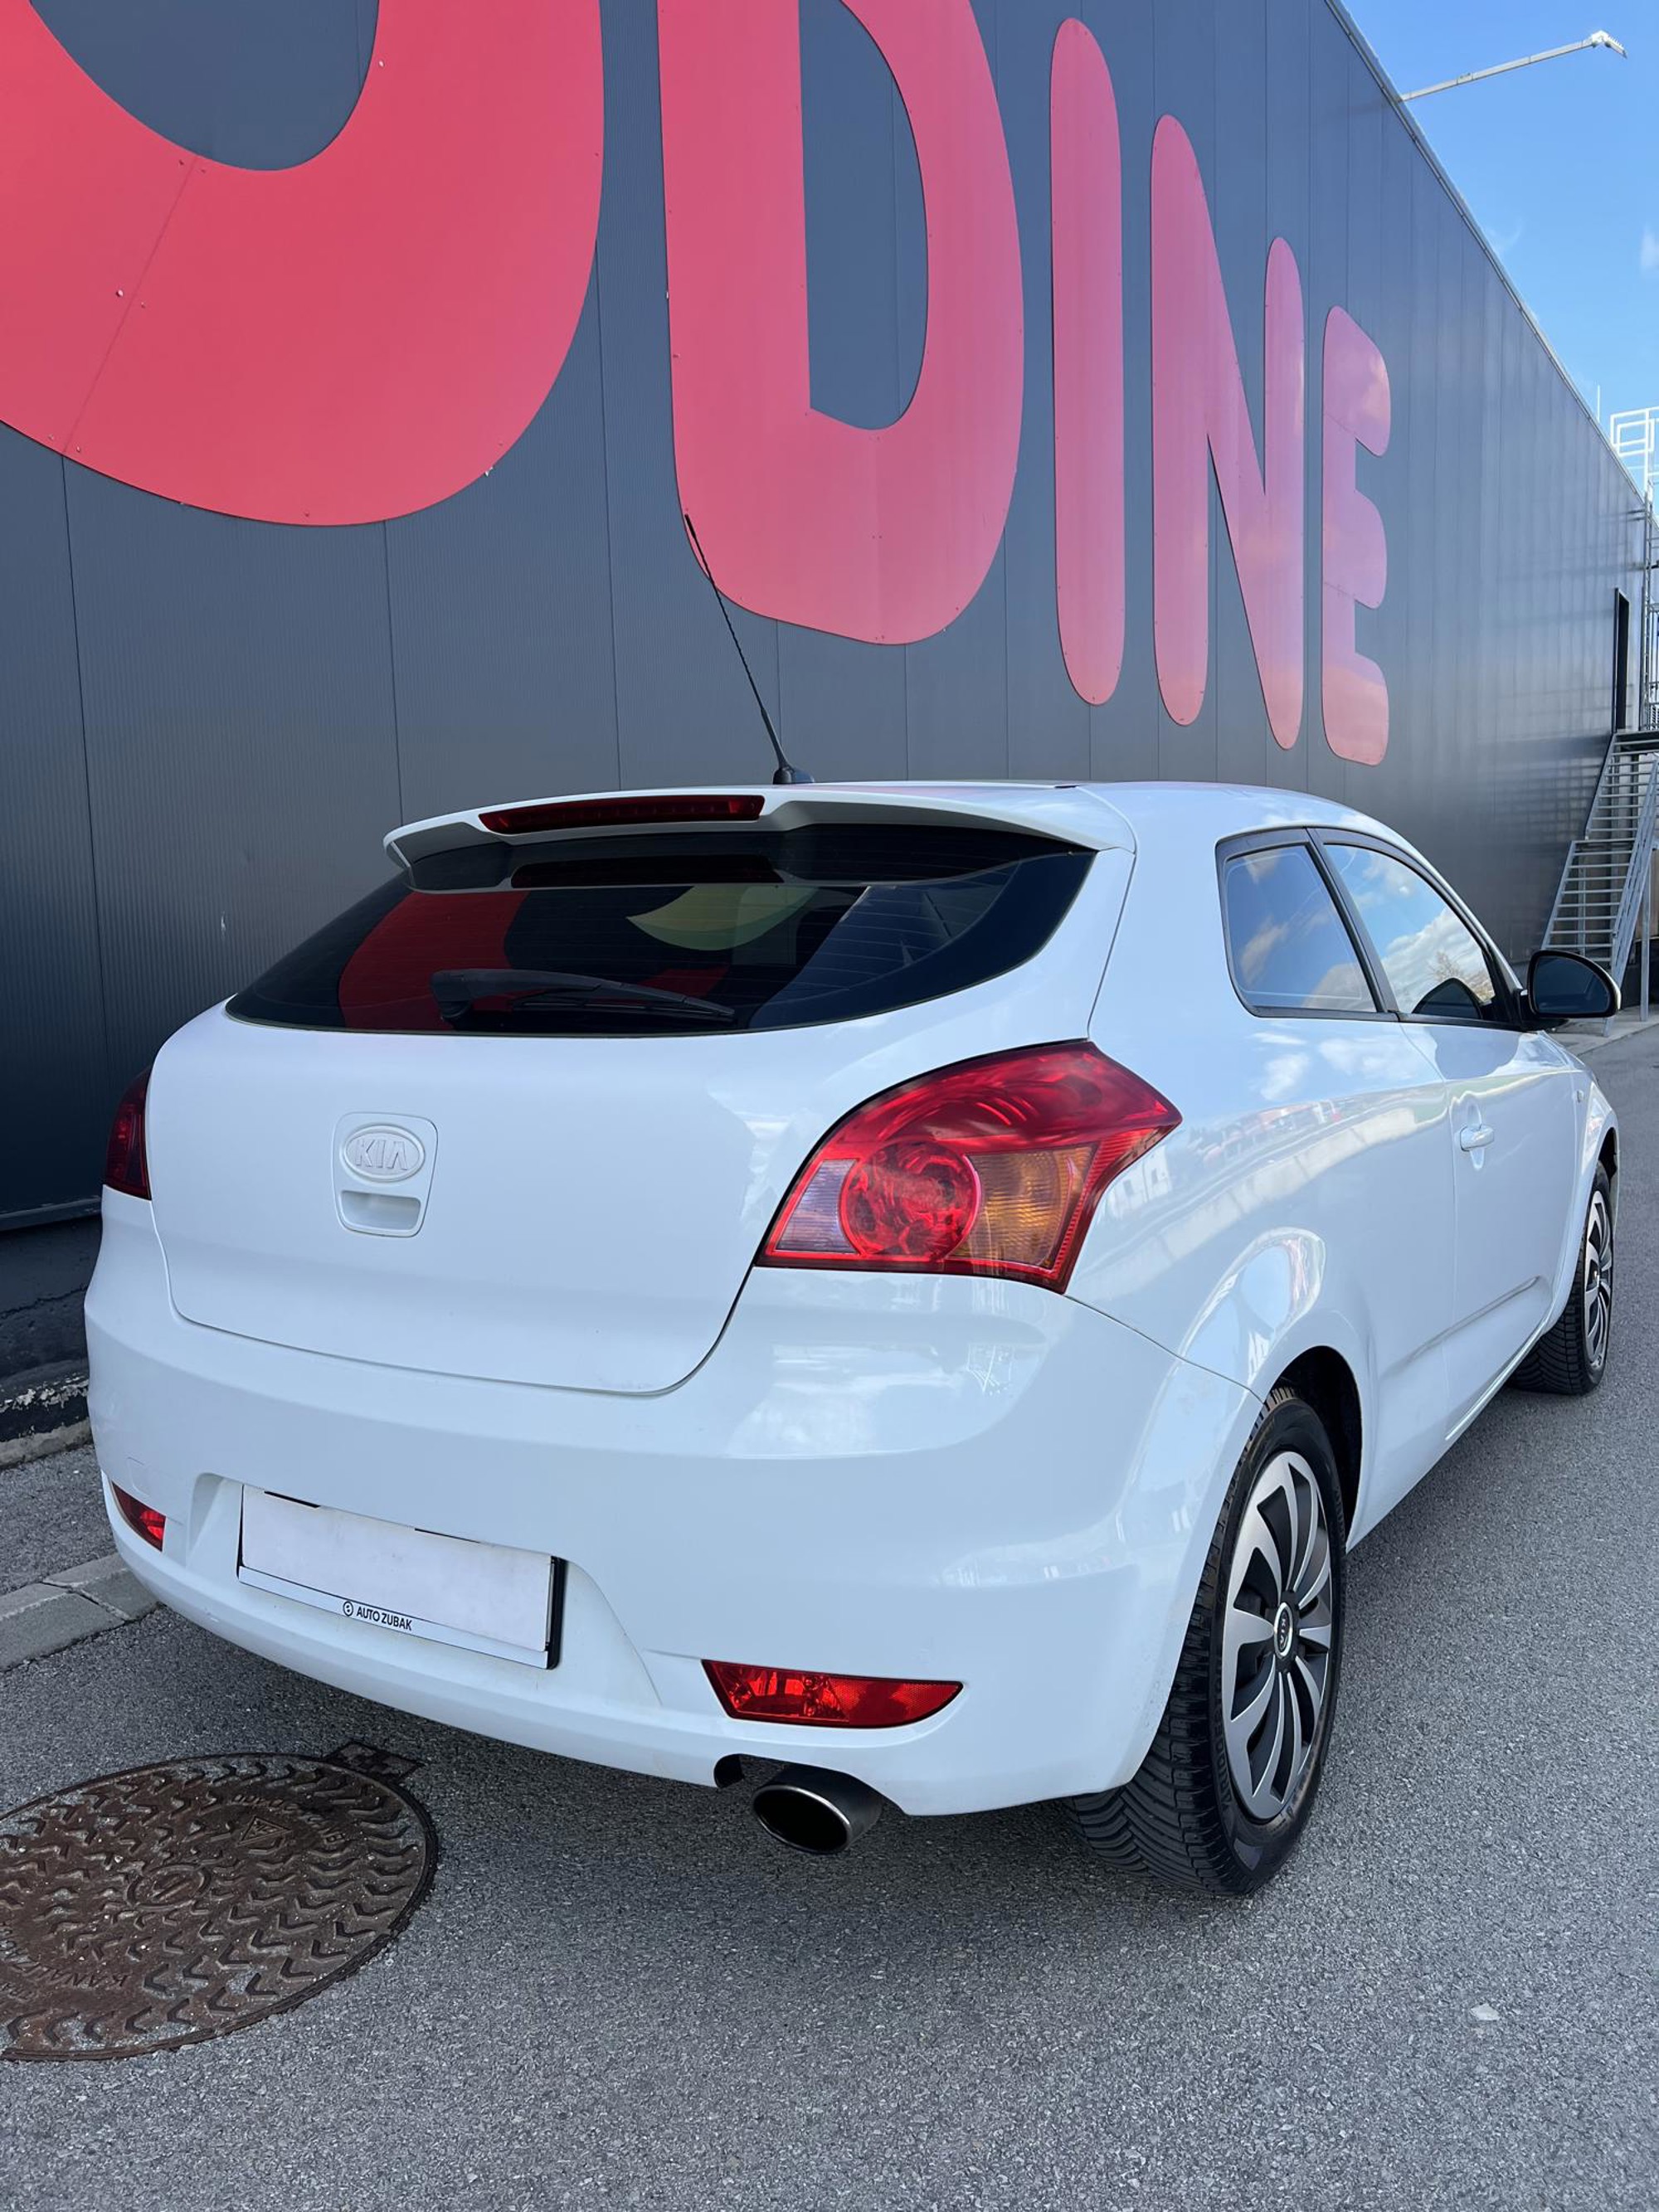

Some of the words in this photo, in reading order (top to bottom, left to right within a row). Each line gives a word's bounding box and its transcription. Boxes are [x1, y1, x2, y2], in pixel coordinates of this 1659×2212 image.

[355, 1140, 408, 1170] KIA
[357, 1606, 380, 1621] AUTO
[381, 1612, 412, 1631] ZUBAK
